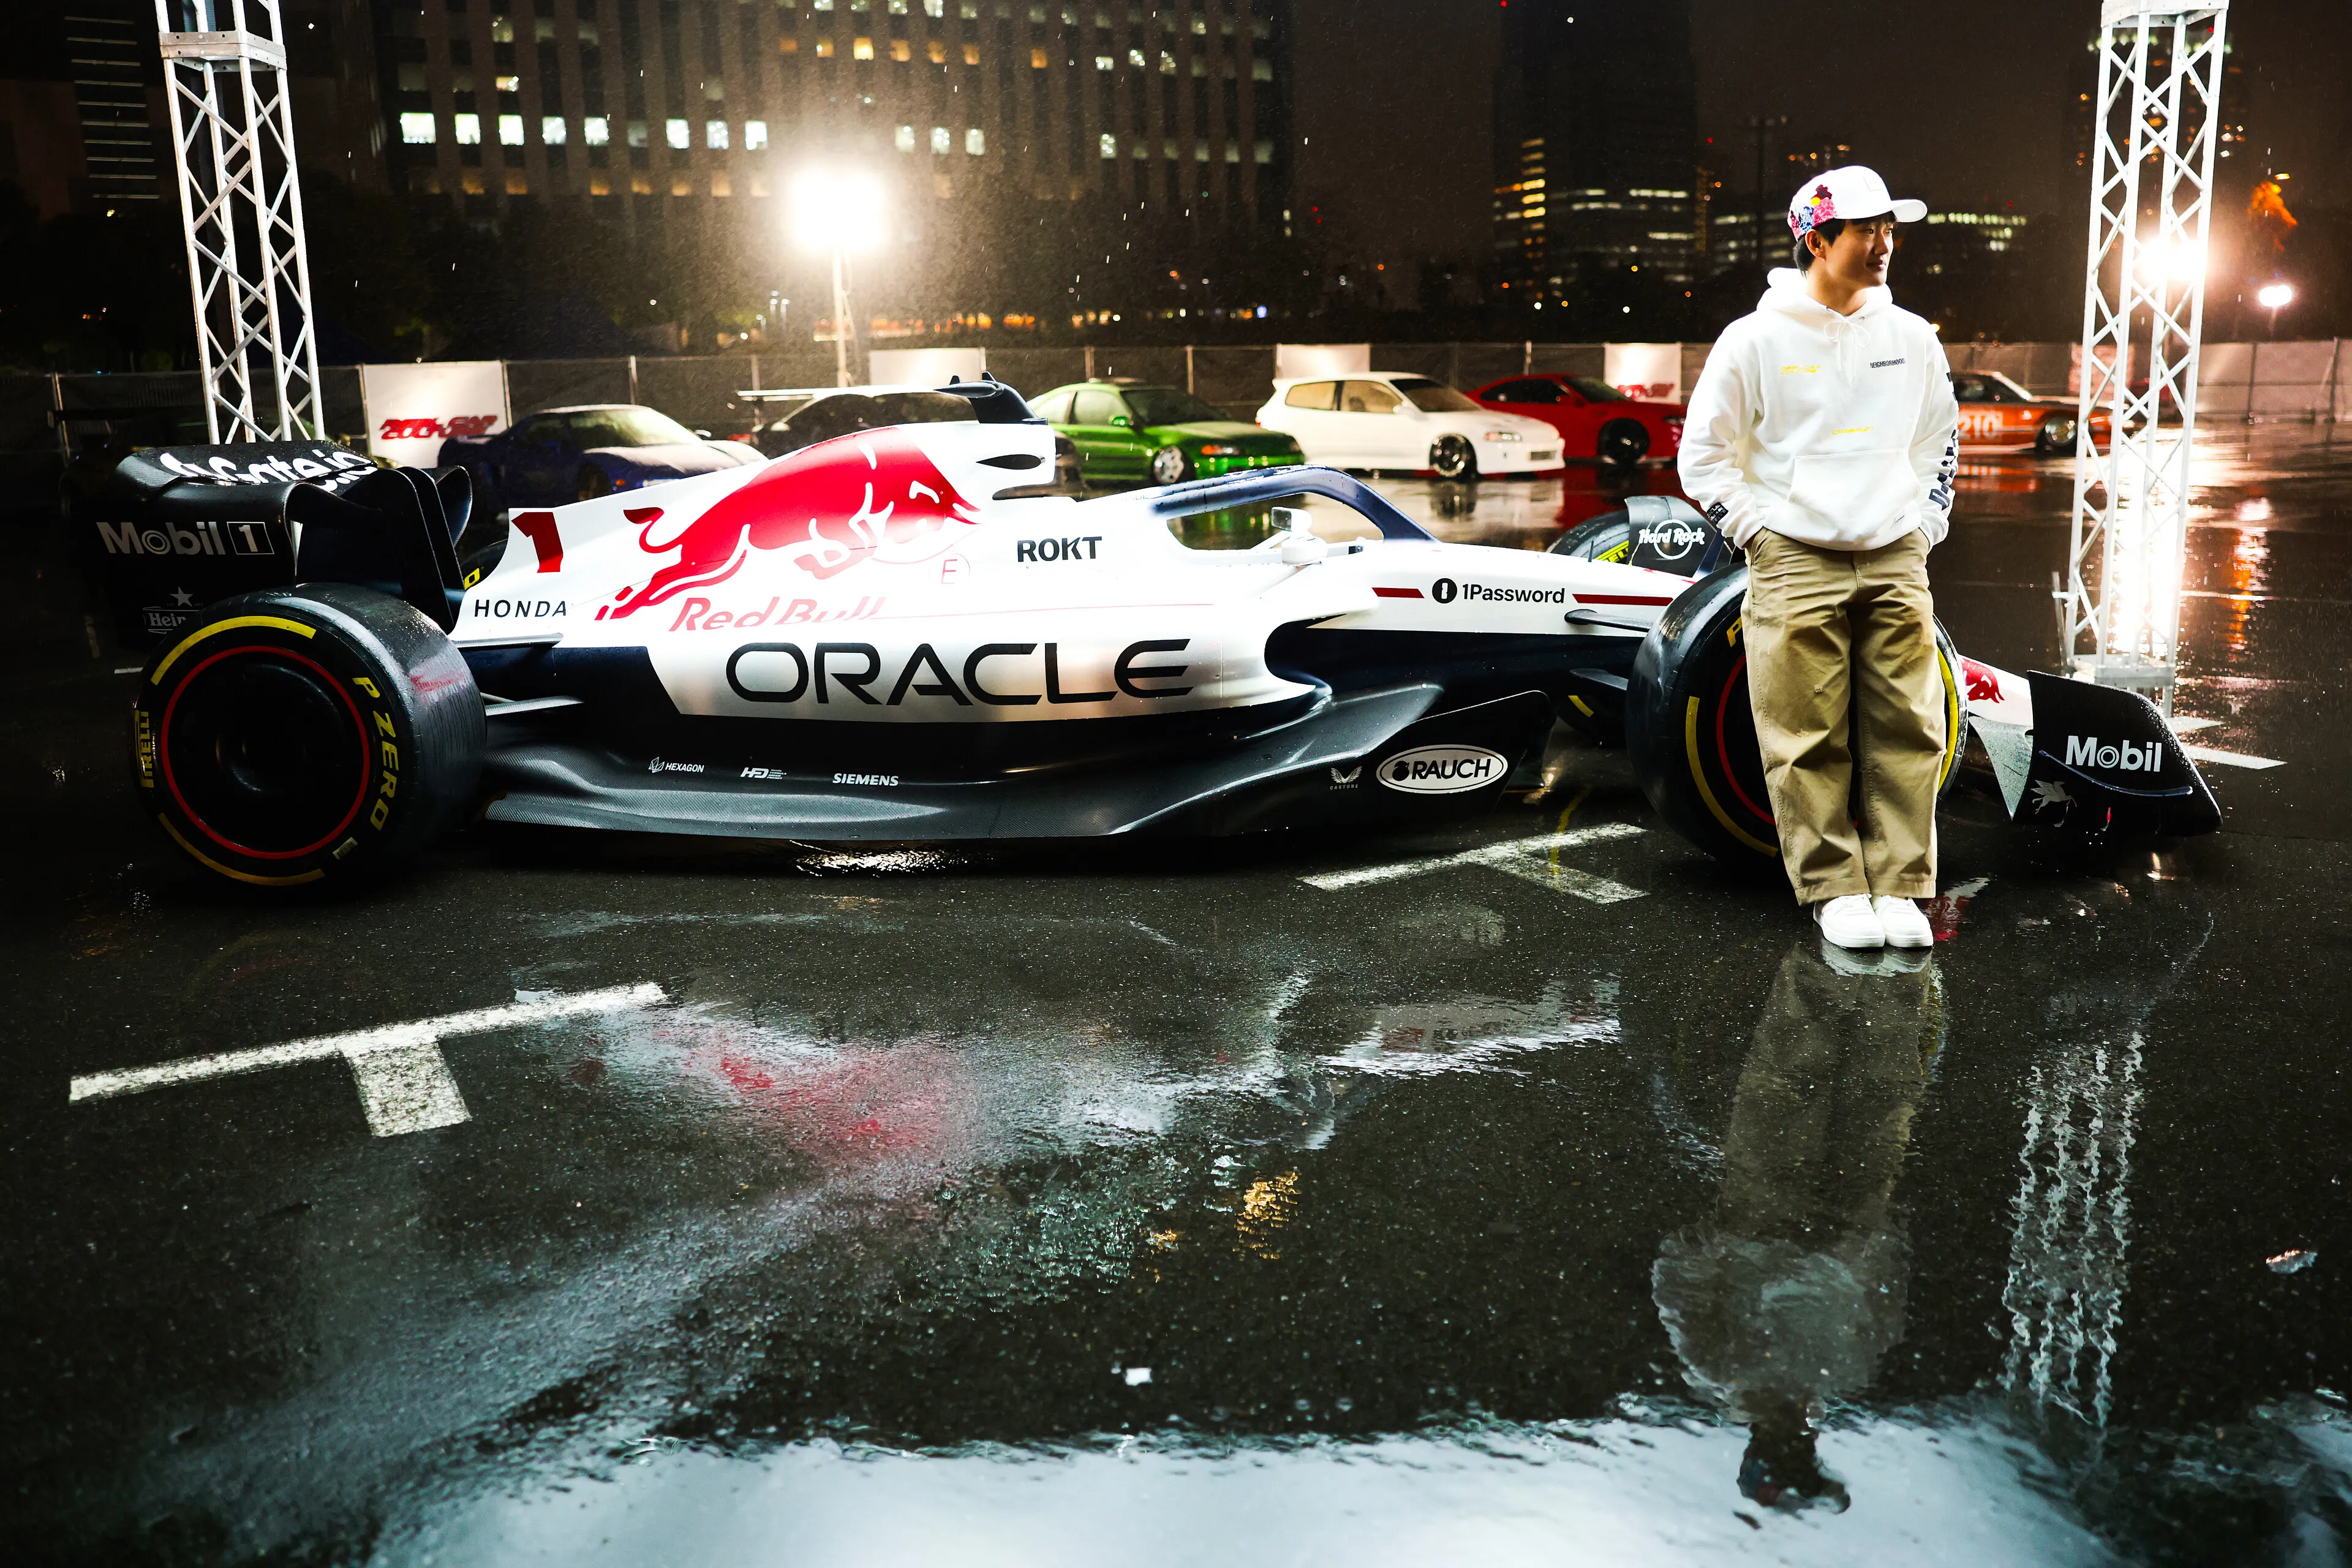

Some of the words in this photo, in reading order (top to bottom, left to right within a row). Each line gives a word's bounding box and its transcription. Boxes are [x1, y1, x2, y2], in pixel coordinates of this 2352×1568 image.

[1958, 413, 1997, 440] 210
[97, 521, 226, 555] Mobil
[238, 524, 257, 552] 1
[511, 511, 564, 573] 1
[1017, 536, 1102, 562] ROKT
[1638, 528, 1672, 545] Hard
[1672, 527, 1706, 546] Rock
[1462, 583, 1566, 604] 1Password
[474, 599, 567, 618] HONDA
[668, 595, 780, 632] Red
[774, 595, 886, 626] Bull
[726, 638, 1194, 706] ORACLE
[134, 709, 154, 788] PIRELLI
[352, 676, 380, 699] P
[370, 710, 399, 831] ZERO
[2065, 735, 2163, 773] Mobil
[665, 762, 705, 773] HEXAGON
[832, 772, 899, 786] SIEMENS
[1411, 759, 1491, 780] RAUCH
